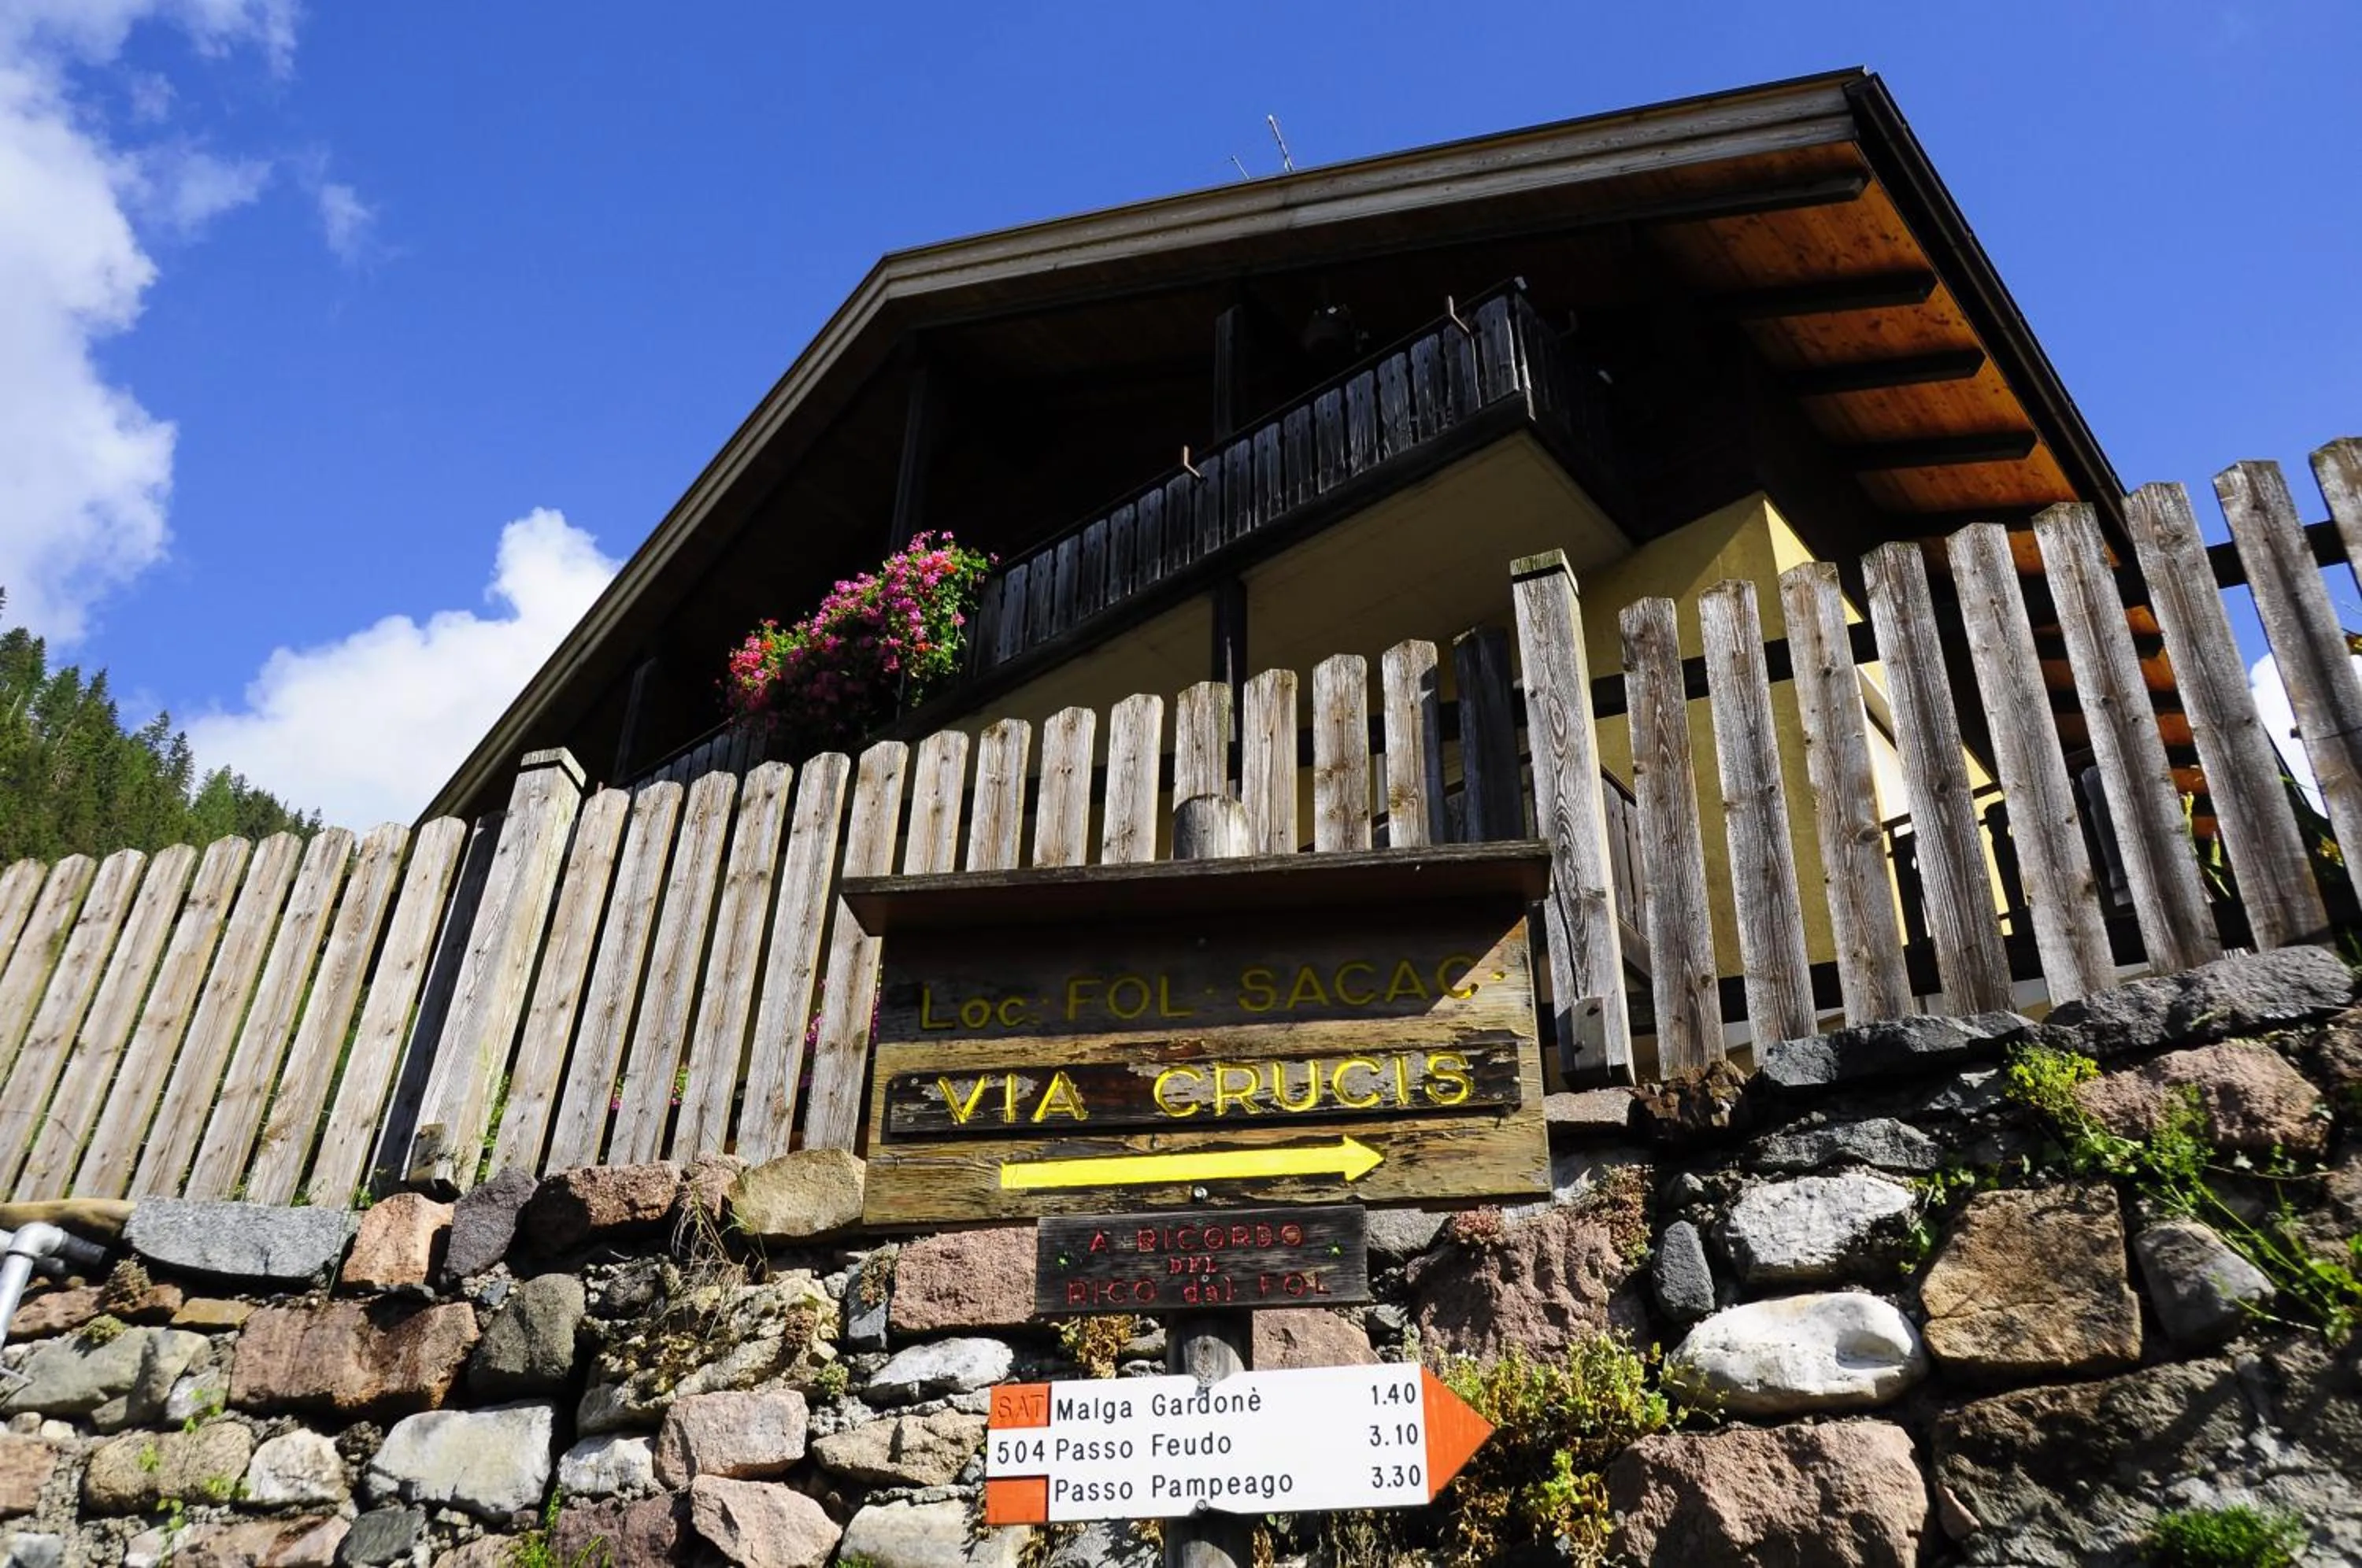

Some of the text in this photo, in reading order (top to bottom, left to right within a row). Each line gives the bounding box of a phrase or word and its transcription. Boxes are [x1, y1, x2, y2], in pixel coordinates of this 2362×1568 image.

[1065, 974, 1194, 1022] FOL
[937, 1052, 1475, 1125] VIA CRUCIS
[1088, 1222, 1305, 1253] A RICORDO
[1066, 1277, 1158, 1306] RICO
[1259, 1272, 1332, 1298] FOL
[998, 1393, 1045, 1418] SAT
[1056, 1381, 1416, 1424] Malga Gardonè 1.40
[998, 1439, 1045, 1464] 504
[1055, 1423, 1418, 1462] Passo Feudo 3.10
[1055, 1463, 1422, 1503] Passo Pampeago 3.30
